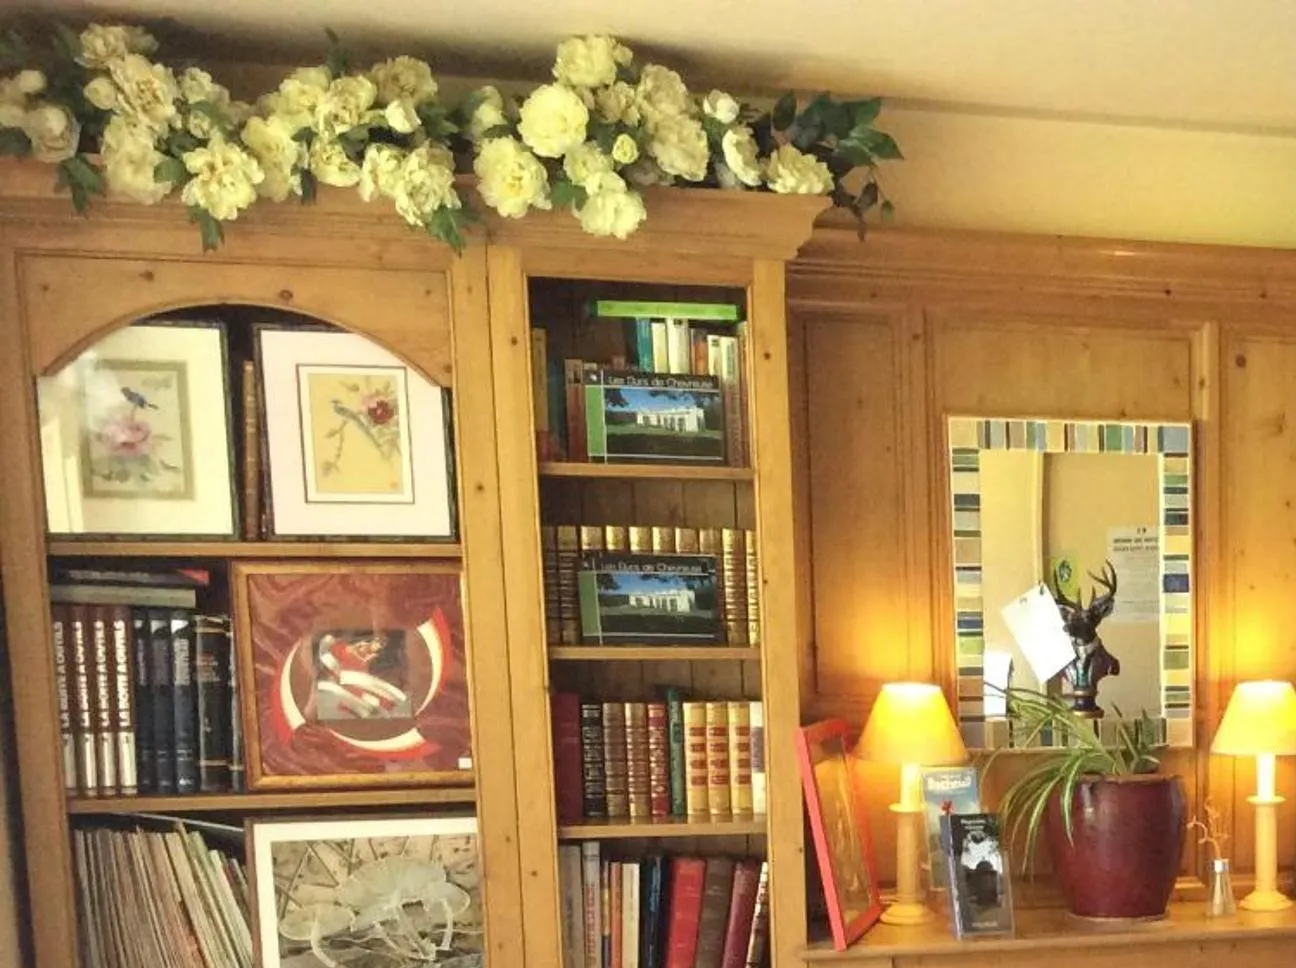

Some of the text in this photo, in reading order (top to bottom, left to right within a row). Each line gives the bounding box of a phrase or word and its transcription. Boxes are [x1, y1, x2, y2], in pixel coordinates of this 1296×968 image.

[607, 376, 625, 386] Les
[626, 375, 649, 387] Ducs
[650, 376, 665, 387] de
[74, 620, 85, 664] OUTILS
[94, 619, 106, 665] OUTILS
[113, 620, 128, 665] OUTILS
[80, 711, 90, 727] LA
[101, 711, 110, 727] LA
[118, 711, 131, 728] LA
